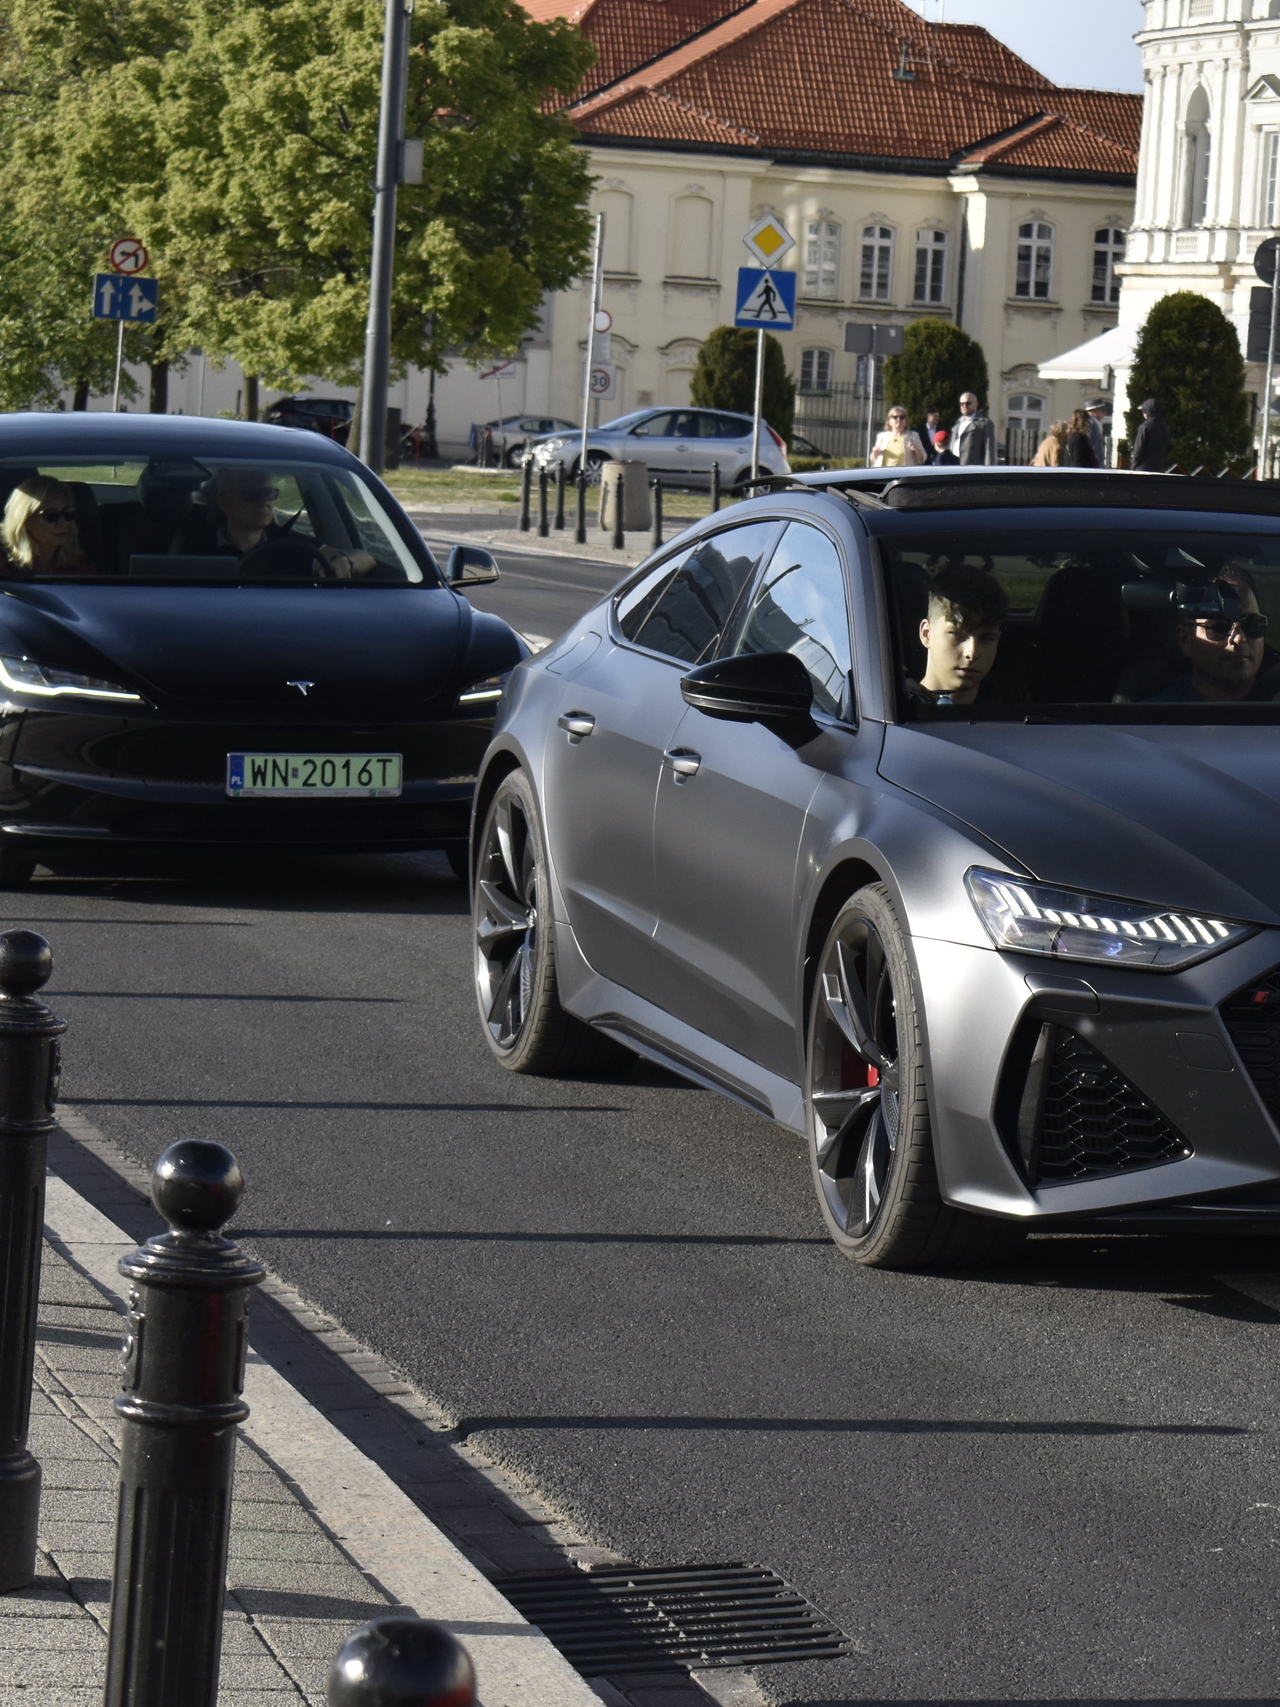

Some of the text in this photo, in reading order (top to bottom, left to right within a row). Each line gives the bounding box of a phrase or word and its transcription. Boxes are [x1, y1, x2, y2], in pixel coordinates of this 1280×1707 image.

[592, 375, 608, 388] 30
[251, 758, 393, 787] WN 2016T
[231, 776, 243, 785] PL
